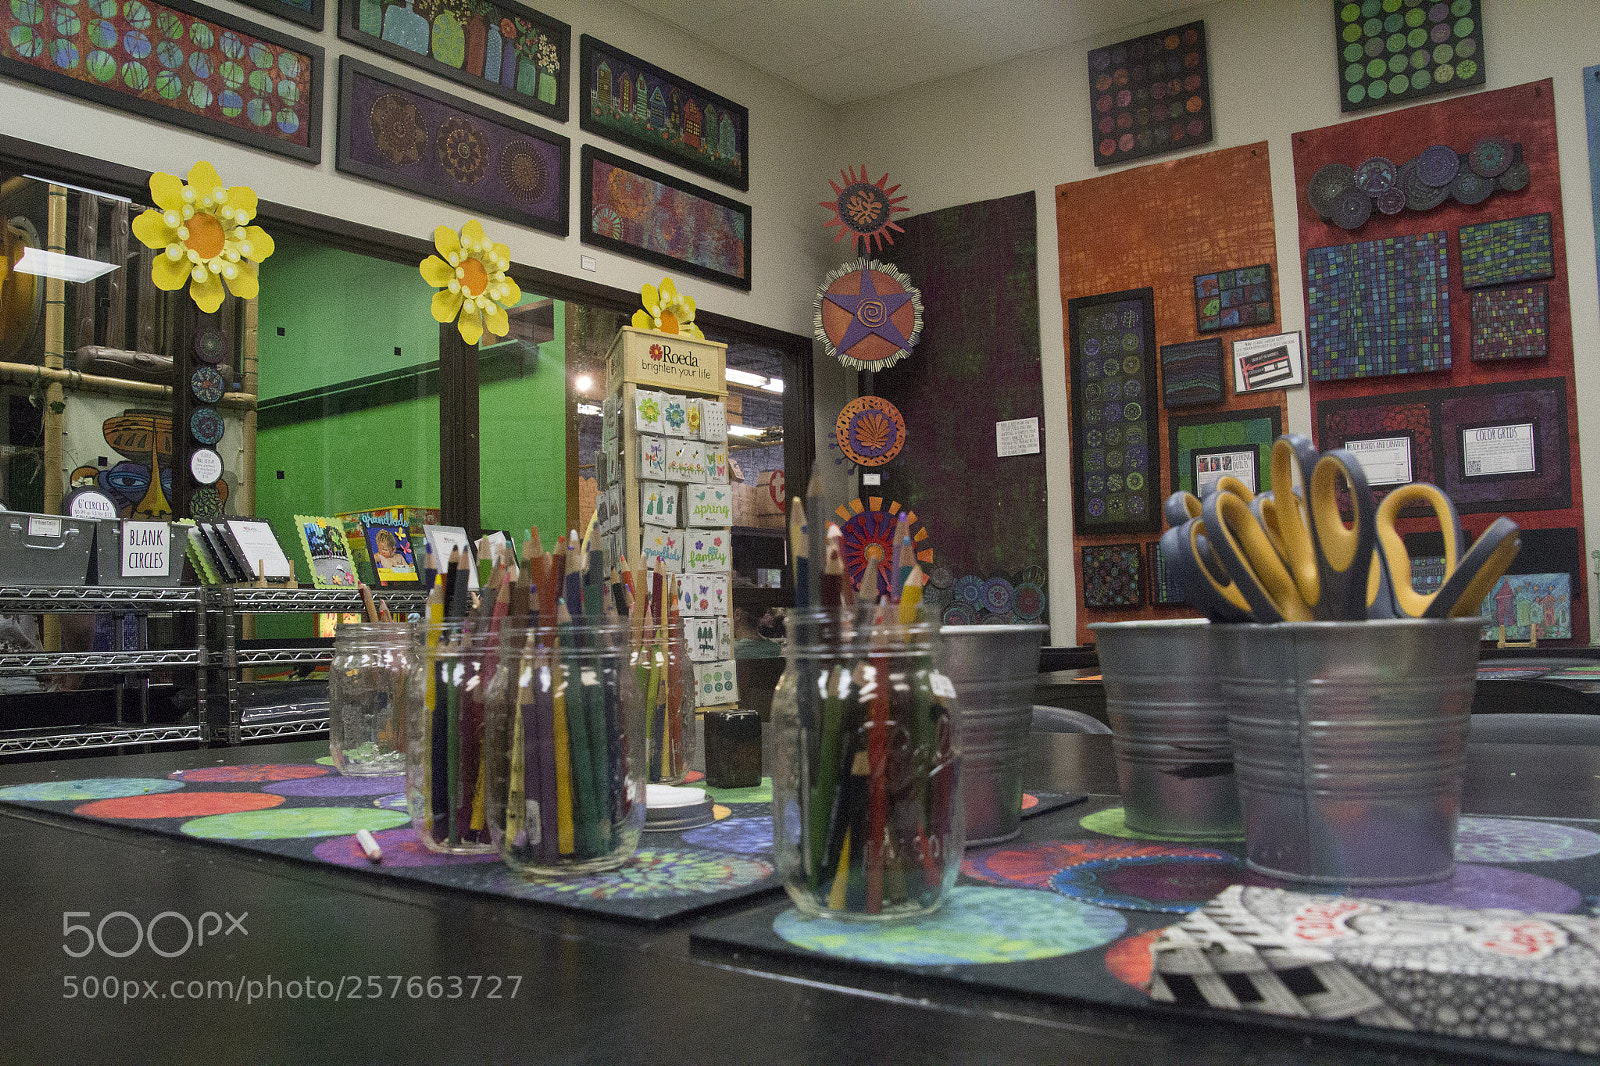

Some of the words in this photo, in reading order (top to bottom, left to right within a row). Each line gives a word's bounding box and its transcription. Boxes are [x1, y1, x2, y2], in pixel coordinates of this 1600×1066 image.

[662, 345, 699, 367] Roeda
[641, 359, 676, 374] brighten
[678, 368, 696, 378] your
[698, 368, 711, 379] life
[1476, 428, 1496, 441] COLOR
[1498, 427, 1518, 440] GRIDS
[694, 503, 729, 519] spring
[361, 512, 409, 528] grandkids
[130, 529, 163, 546] BLANK
[128, 552, 164, 569] CIRCLES
[688, 547, 727, 568] family
